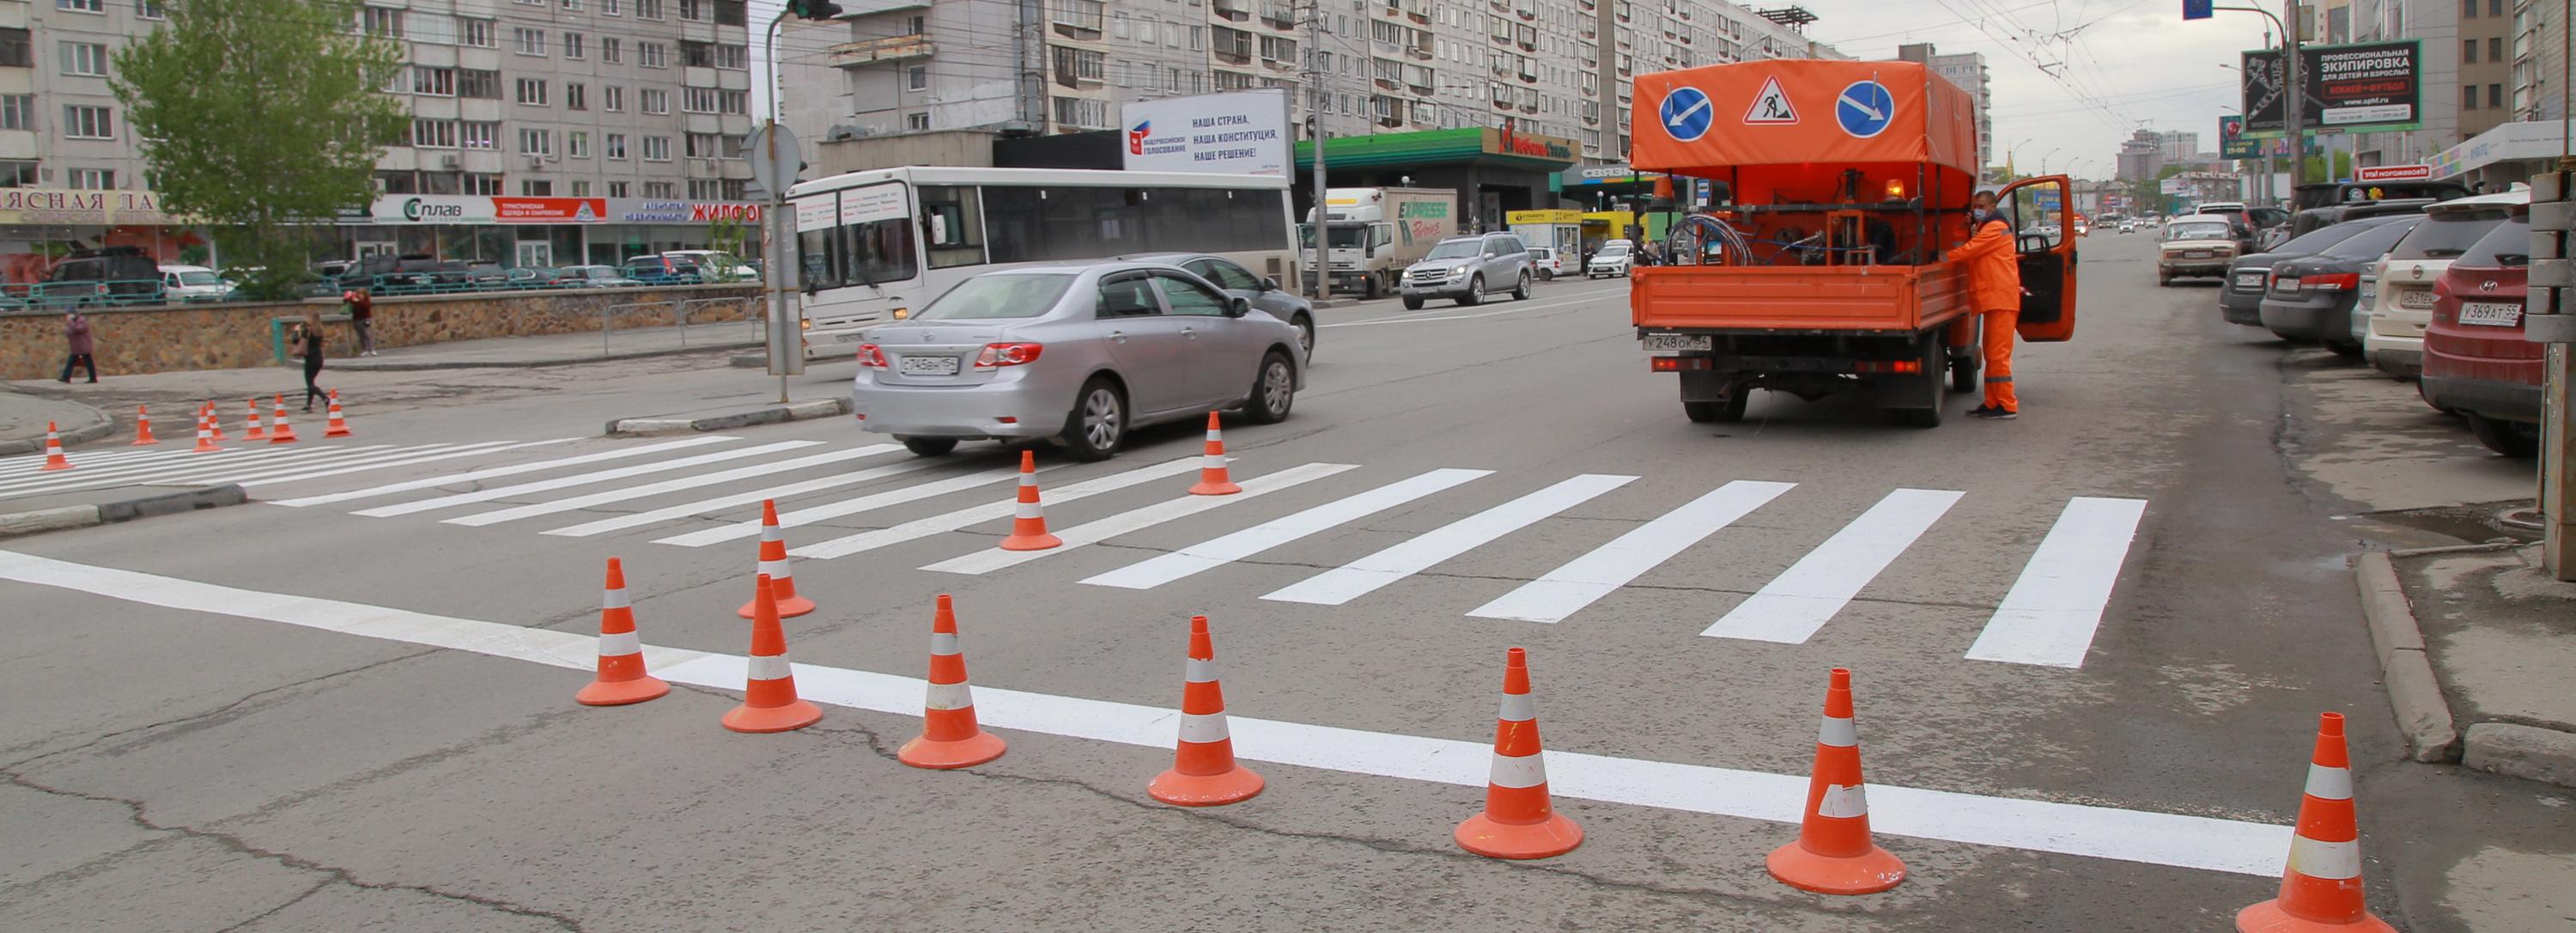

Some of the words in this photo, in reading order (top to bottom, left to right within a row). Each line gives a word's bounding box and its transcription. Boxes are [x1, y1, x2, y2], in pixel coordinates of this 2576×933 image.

[2321, 49, 2409, 61] ПРОФЕССИОНАЛЬНАЯ
[2321, 58, 2410, 73] ЭКИПИРОВКА
[2321, 73, 2337, 82] ДЛЯ
[2338, 70, 2362, 80] ДЕТЕЙ
[2370, 68, 2410, 77] ВЗРОСЛЫХ
[1193, 118, 1215, 128] НАША
[1218, 114, 1250, 126] СТРАНА,
[1194, 135, 1216, 144] НАША
[1218, 130, 1278, 142] КОНСТИТУЦИЯ,
[1144, 144, 1186, 156] ГОЛОСОВАНИЕ
[1194, 151, 1217, 162] НАШЕ
[1218, 148, 1256, 160] РЕШЕНИЕ!
[0, 192, 104, 210] ЯСНАЯ
[404, 198, 462, 221] Сплав
[2506, 305, 2518, 316] 55
